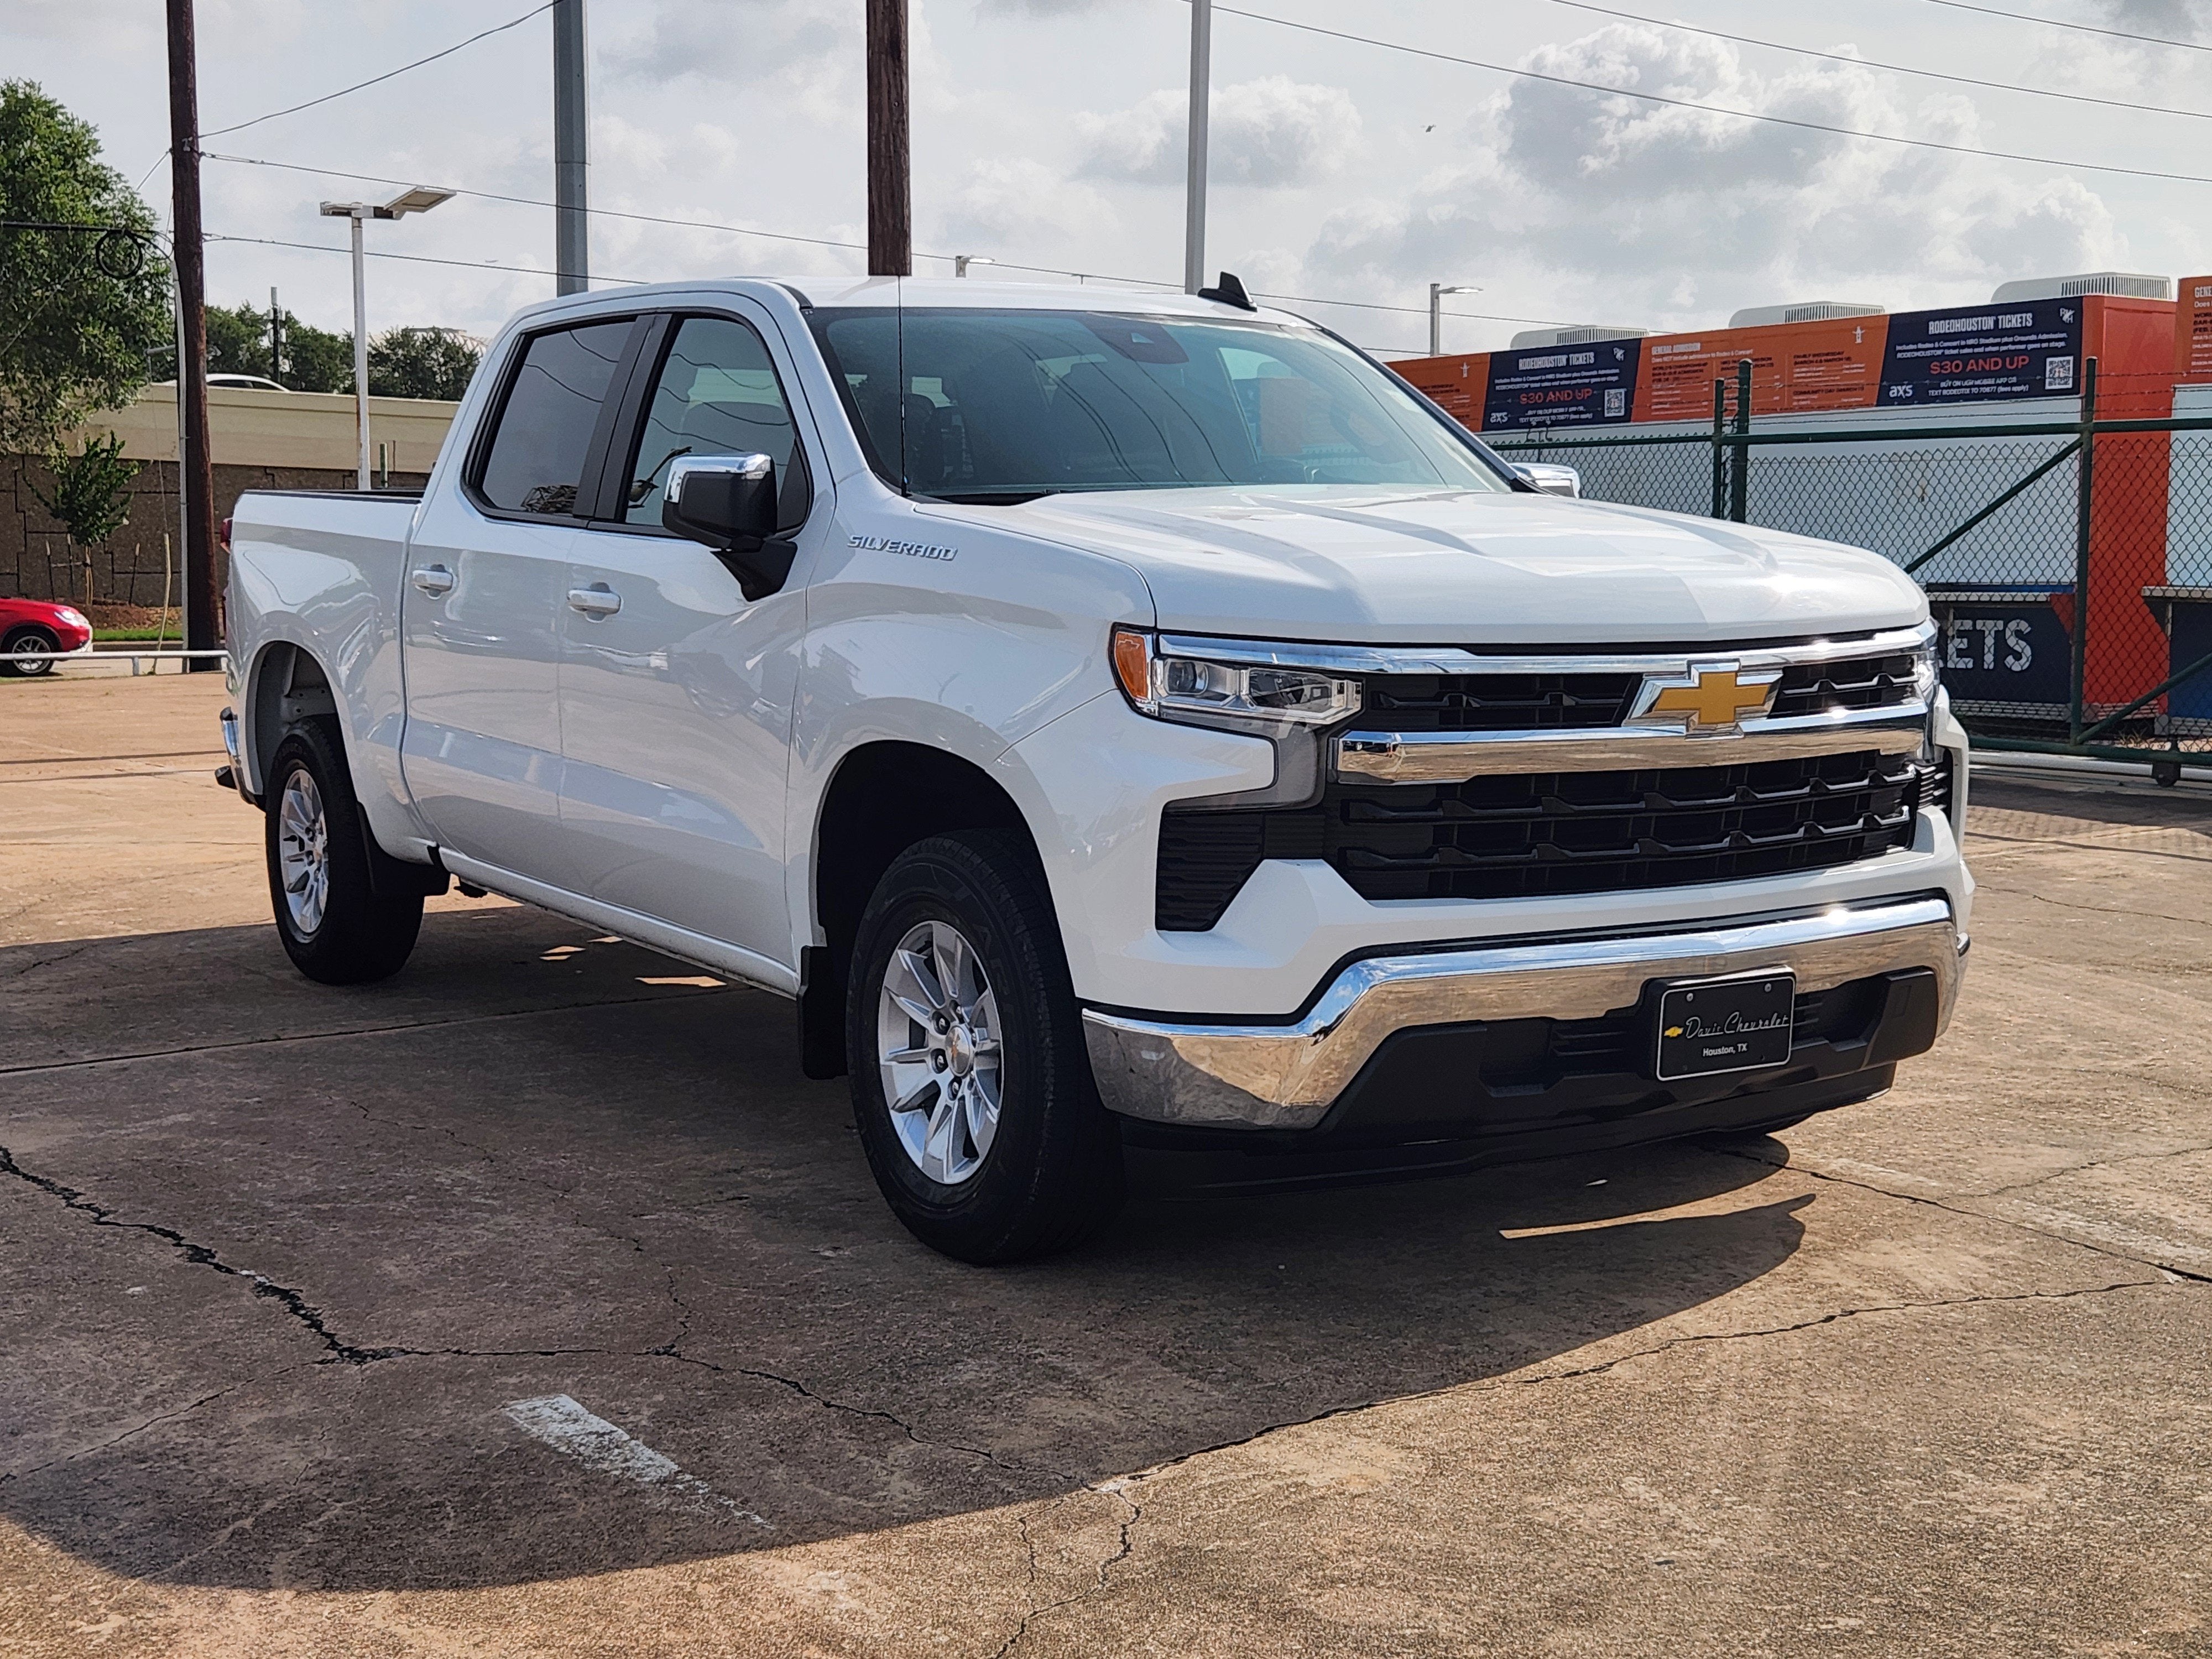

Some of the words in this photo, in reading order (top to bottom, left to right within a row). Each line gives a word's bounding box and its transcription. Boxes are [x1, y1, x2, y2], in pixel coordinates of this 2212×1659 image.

[1997, 313, 2032, 329] TICKETS
[1569, 352, 1594, 366] TICKETS
[1965, 357, 2002, 372] AND
[2006, 355, 2029, 369] UP
[1546, 389, 1573, 402] AND
[1575, 388, 1593, 400] UP
[1888, 385, 1913, 398] axs
[847, 535, 958, 561] SILVERADO
[1939, 619, 2032, 671] ETS
[1724, 1011, 1789, 1034] Chevrolet
[1703, 1046, 1735, 1057] Houston,
[1737, 1042, 1748, 1052] TX
